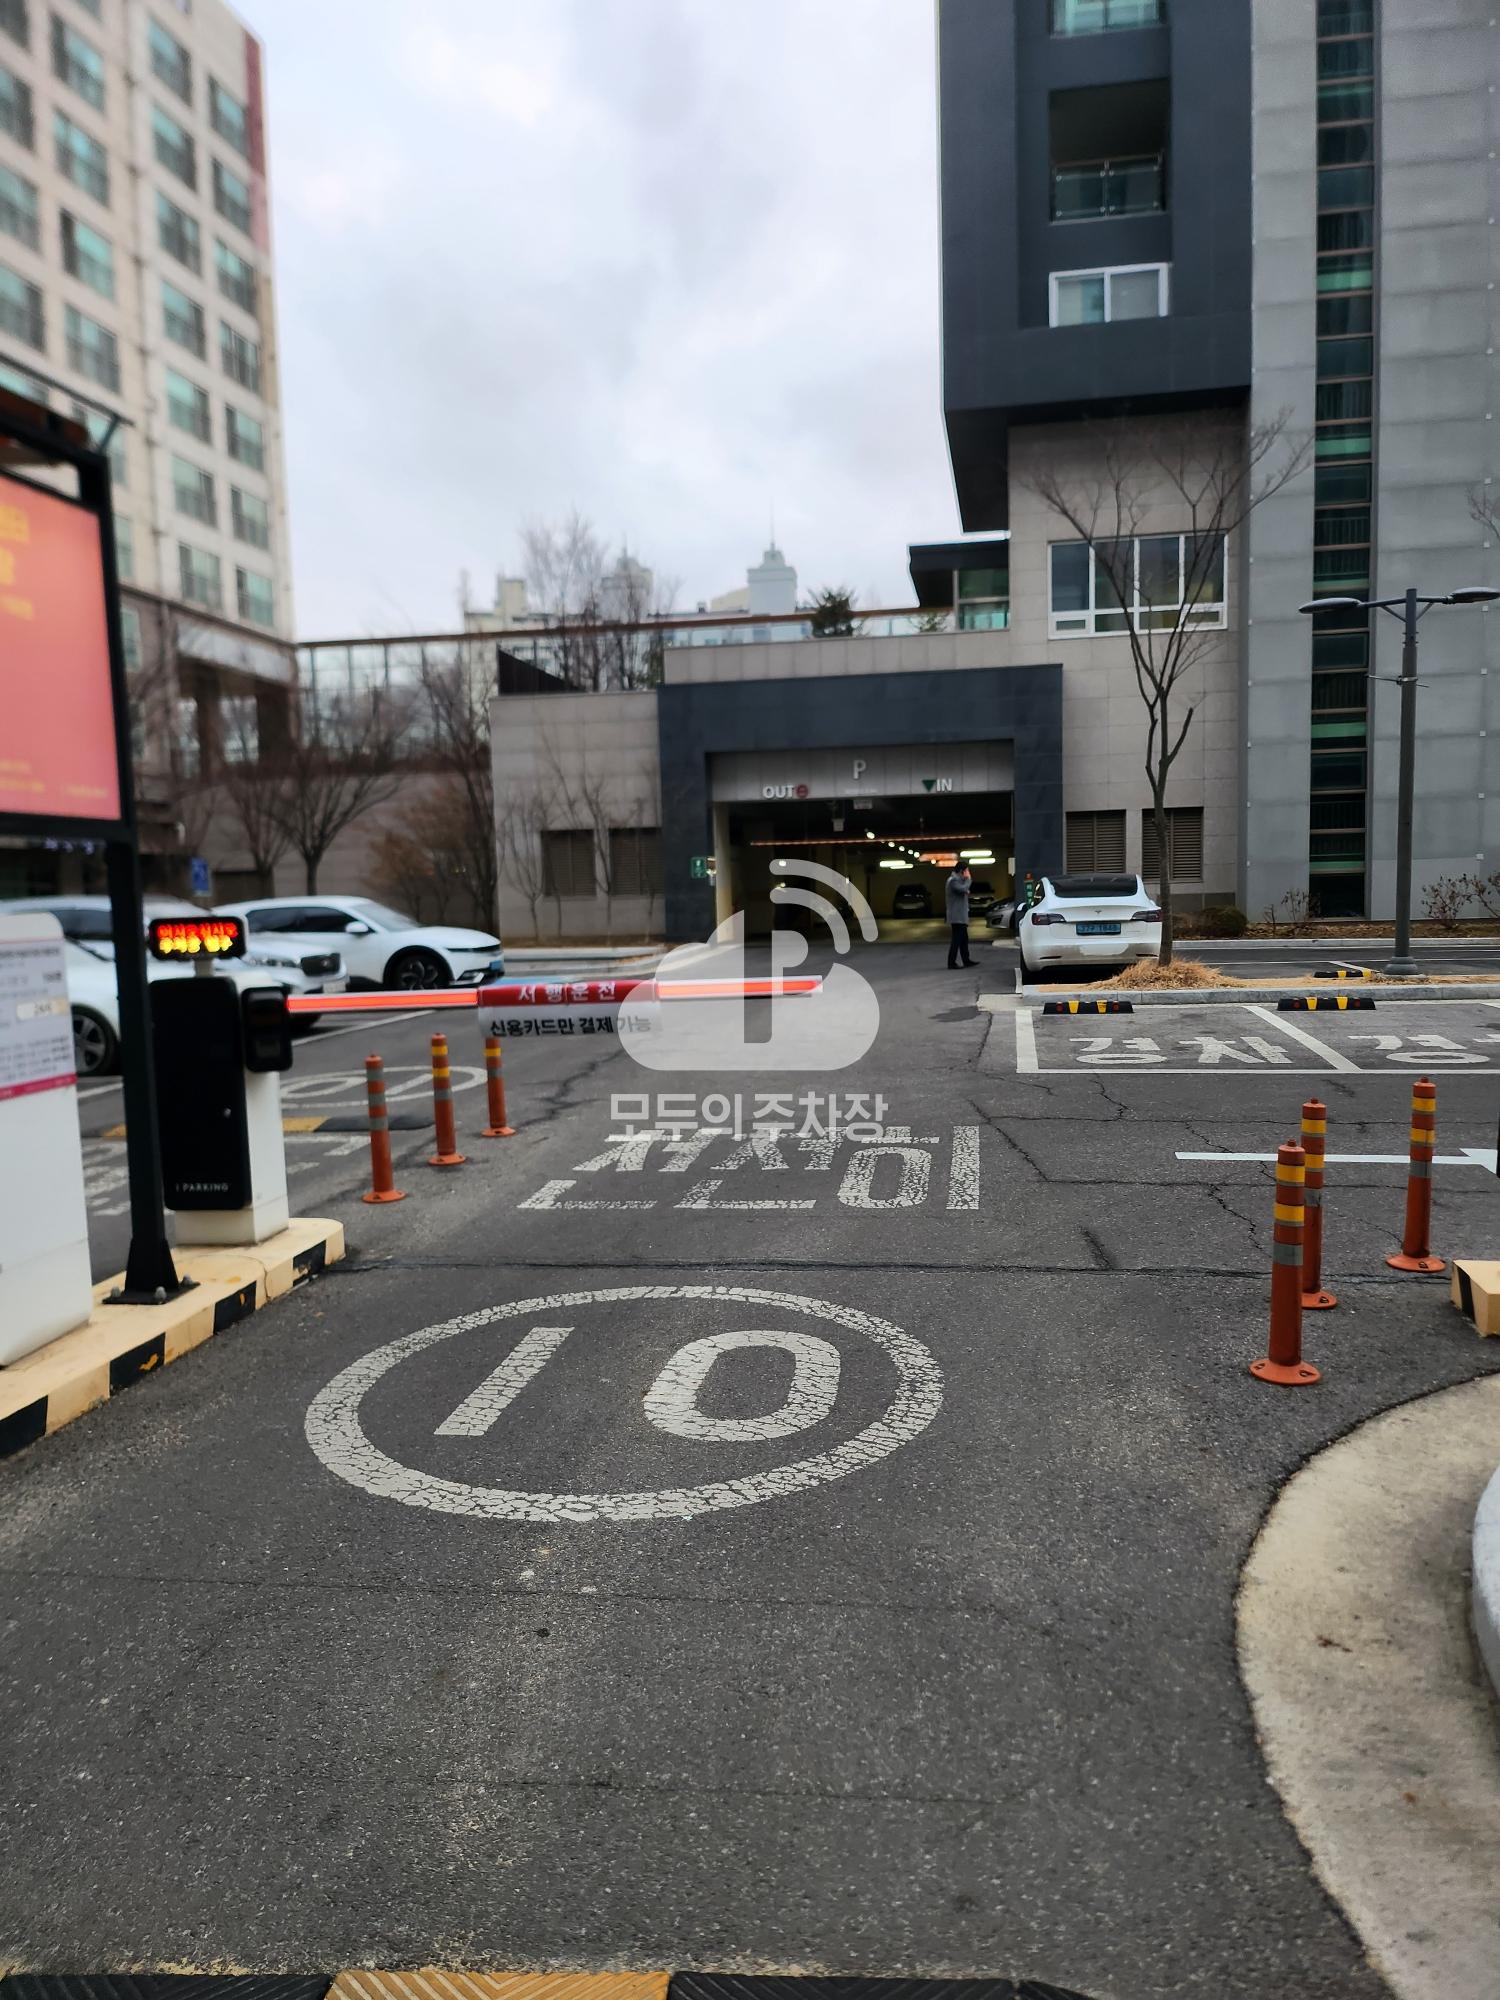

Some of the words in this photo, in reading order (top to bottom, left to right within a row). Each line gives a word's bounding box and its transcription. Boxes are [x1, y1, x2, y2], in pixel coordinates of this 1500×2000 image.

[852, 759, 867, 779] P
[762, 784, 795, 799] OUT
[936, 778, 953, 792] IN
[490, 1017, 575, 1037] 신용카드만
[578, 1016, 614, 1035] 결제
[617, 1015, 651, 1032] 가능
[1068, 1036, 1294, 1065] 경차
[516, 1125, 981, 1211] 천천히
[434, 1326, 842, 1442] 10
